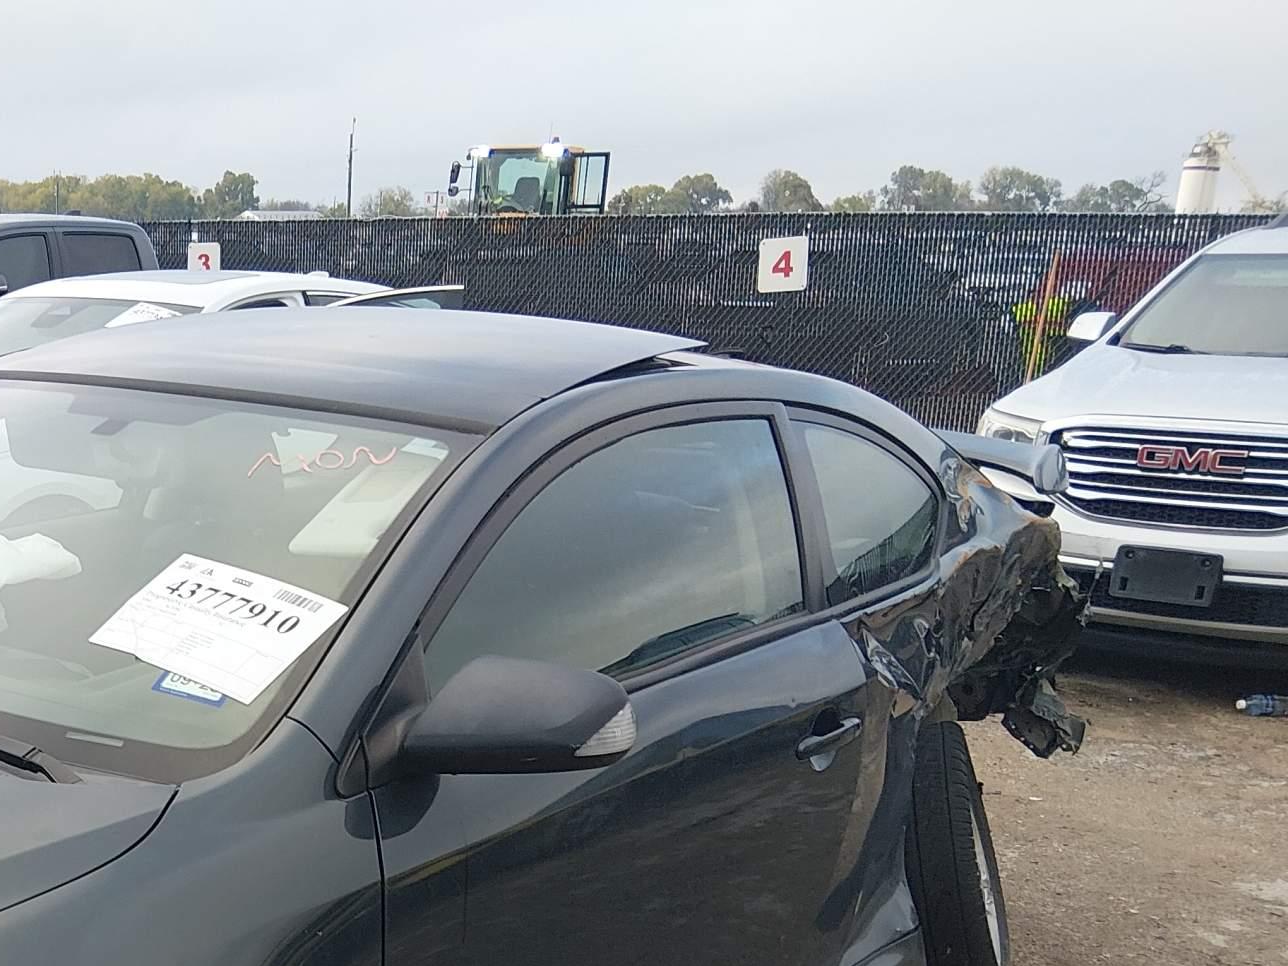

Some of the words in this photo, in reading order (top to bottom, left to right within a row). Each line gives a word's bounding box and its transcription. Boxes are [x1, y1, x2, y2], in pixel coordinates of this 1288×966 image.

[197, 253, 210, 270] 3
[772, 250, 794, 278] 4
[1136, 444, 1249, 474] GMC
[165, 579, 301, 634] 43777910
